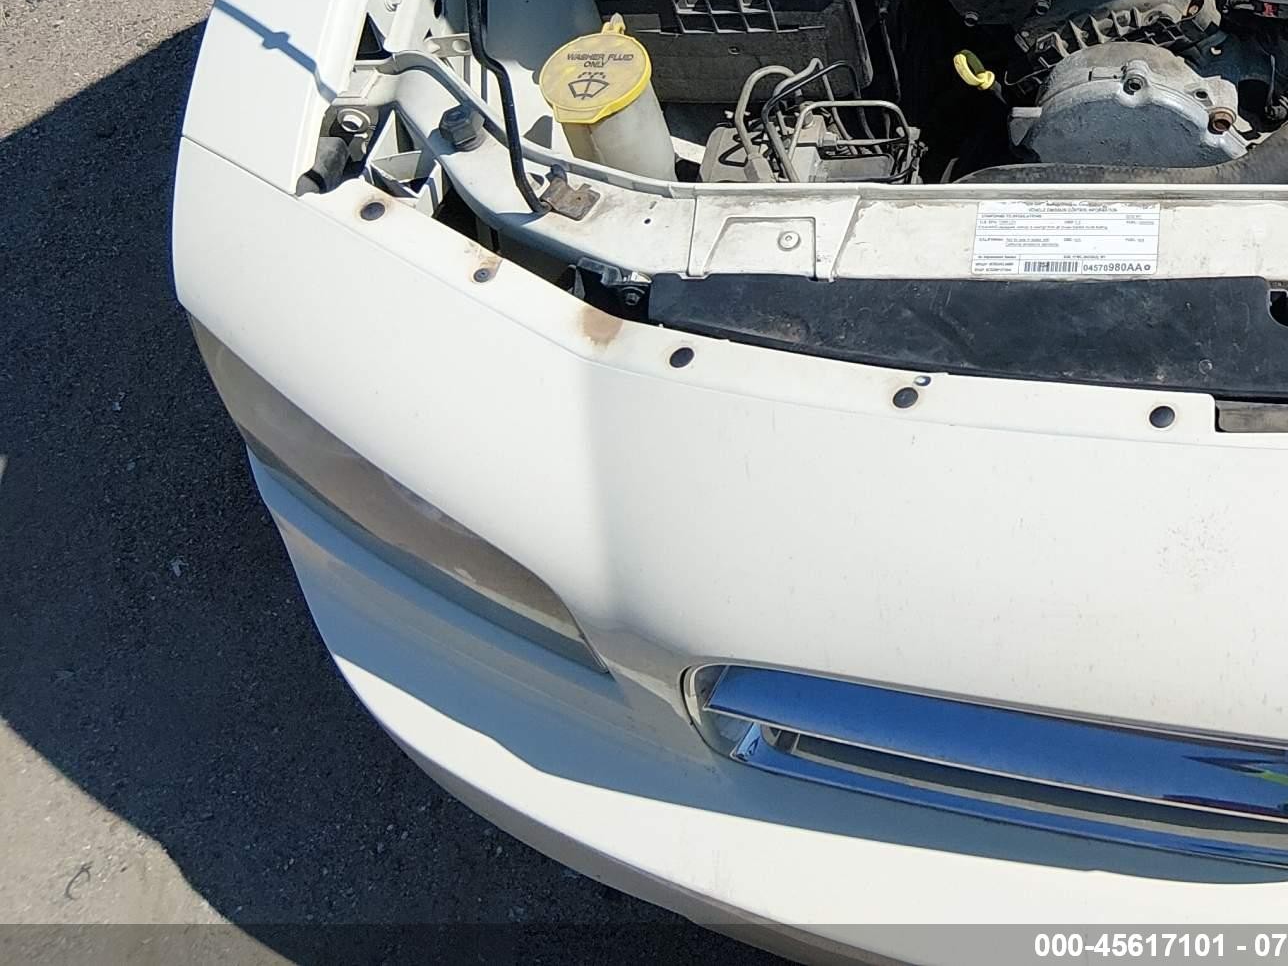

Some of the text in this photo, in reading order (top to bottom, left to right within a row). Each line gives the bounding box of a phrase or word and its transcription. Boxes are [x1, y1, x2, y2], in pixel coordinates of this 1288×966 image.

[567, 53, 634, 61] WASHER FLUID
[583, 58, 609, 68] ONLY
